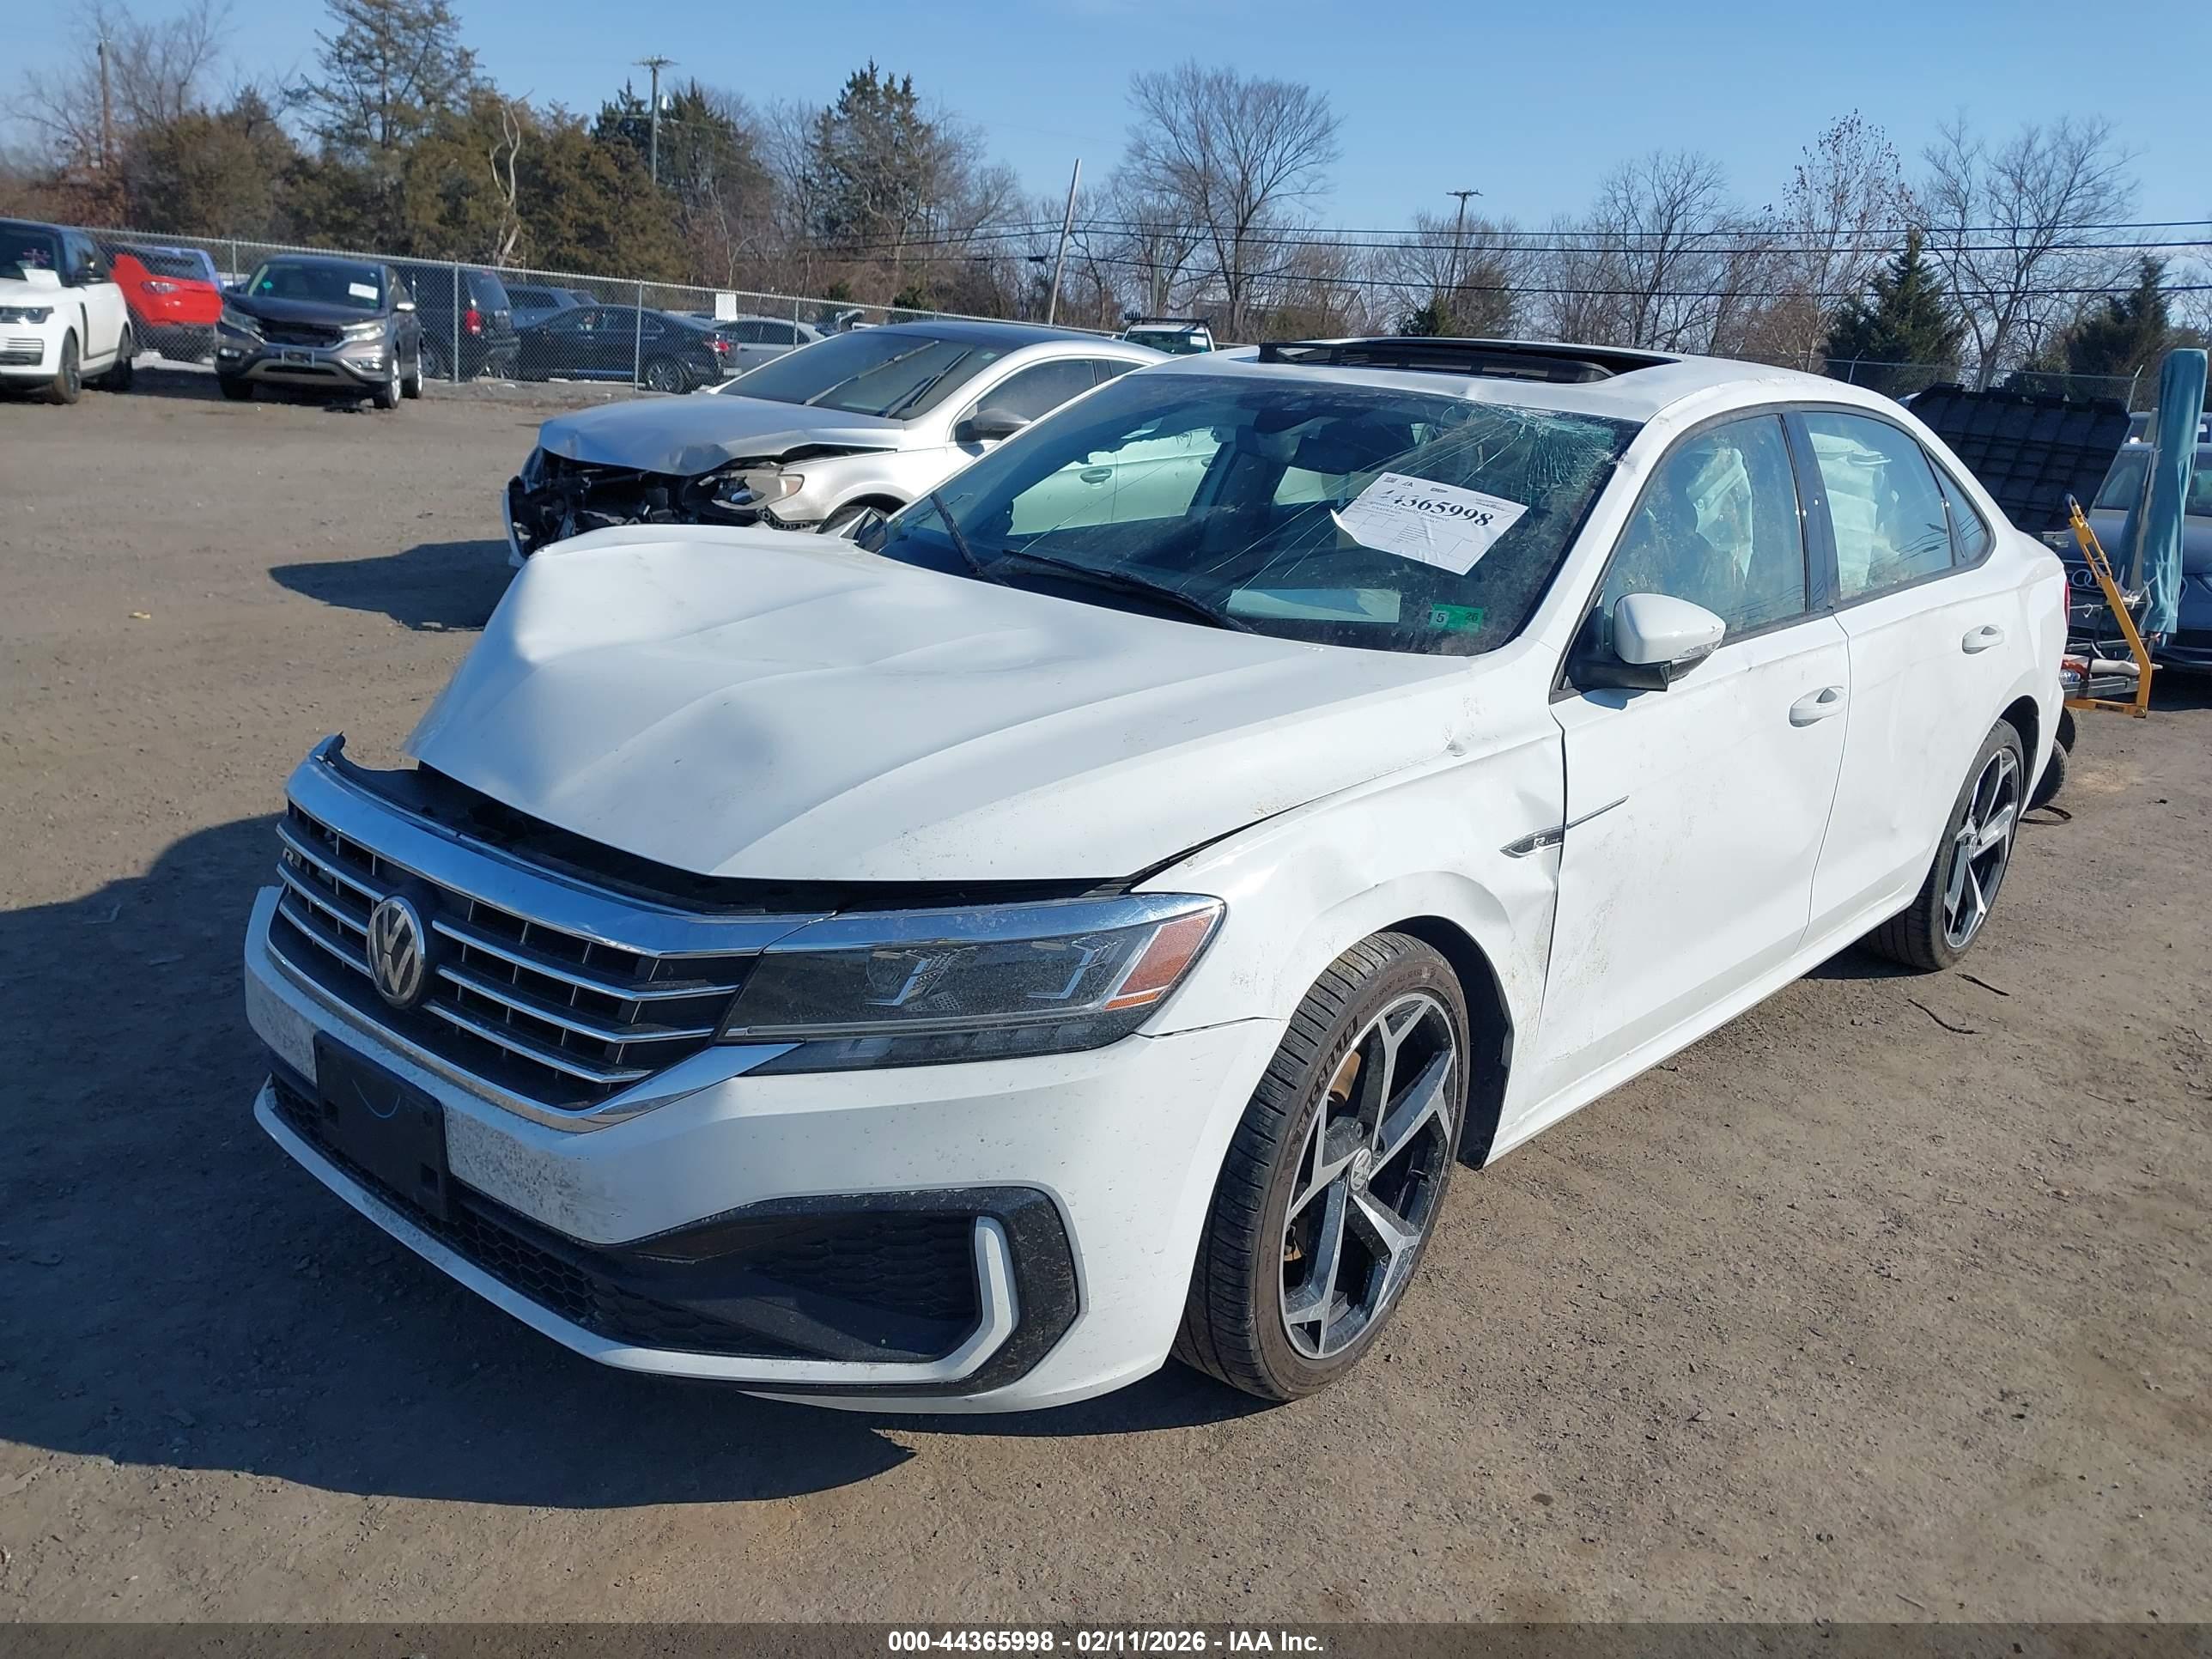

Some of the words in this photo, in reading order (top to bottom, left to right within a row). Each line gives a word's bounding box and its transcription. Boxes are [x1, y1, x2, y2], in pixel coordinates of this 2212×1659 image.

[1436, 612, 1446, 623] 5
[368, 898, 422, 1003] VW
[1297, 1016, 1358, 1134] MICHELIN
